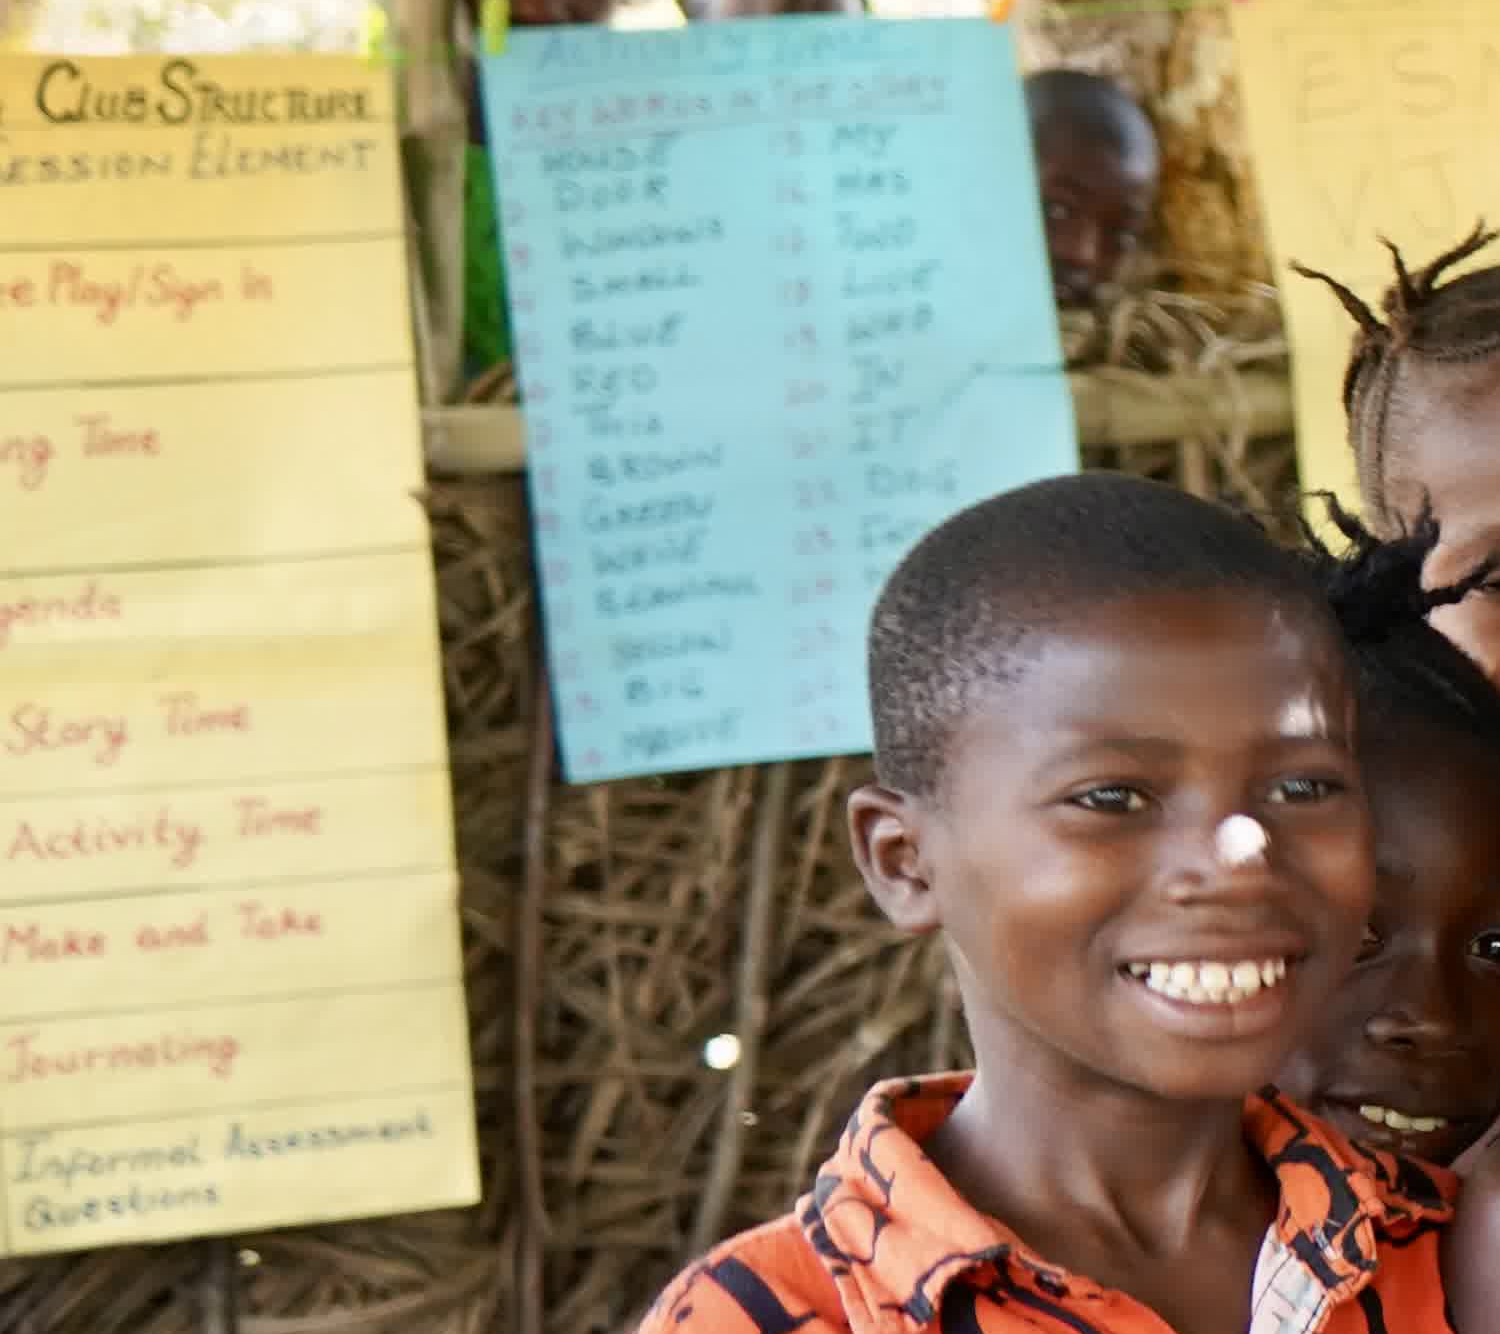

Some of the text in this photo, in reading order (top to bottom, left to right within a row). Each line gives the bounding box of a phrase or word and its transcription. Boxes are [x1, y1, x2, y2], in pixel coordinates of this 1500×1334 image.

[72, 410, 161, 458] Time
[4, 691, 249, 766] Story Time
[6, 795, 322, 868] Activity Time
[133, 913, 208, 951] and
[224, 1108, 434, 1160] Assessment
[22, 1181, 221, 1234] Questions
